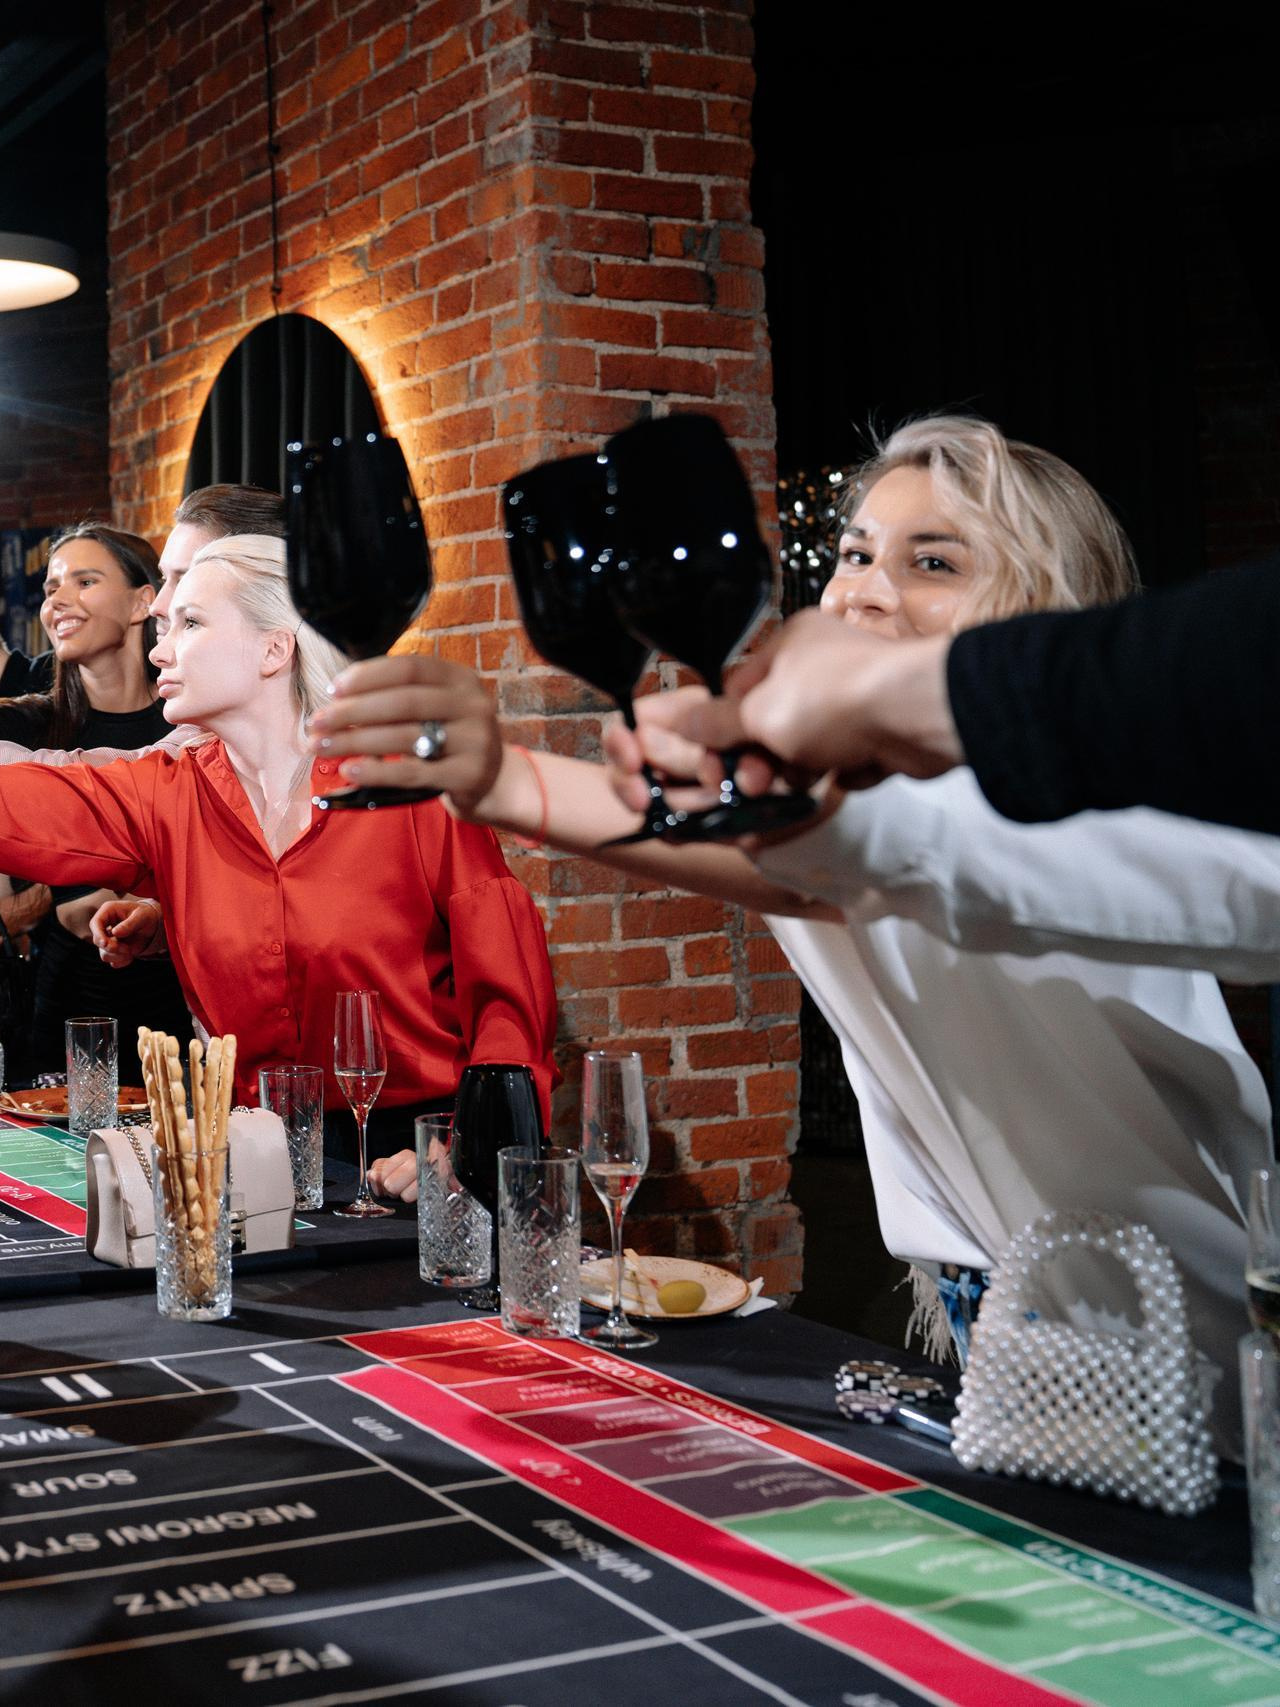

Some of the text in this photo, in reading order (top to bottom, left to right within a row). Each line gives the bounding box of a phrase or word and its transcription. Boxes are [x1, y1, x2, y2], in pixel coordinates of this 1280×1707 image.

[0, 1241, 83, 1255] any time
[40, 1372, 114, 1402] II
[352, 1416, 405, 1442] rum
[12, 1468, 140, 1500] SOUR
[109, 1501, 317, 1545] NEGRONI
[531, 1518, 653, 1585] whiskey
[114, 1572, 298, 1616] SPRITZ
[226, 1642, 355, 1685] FIZZ
